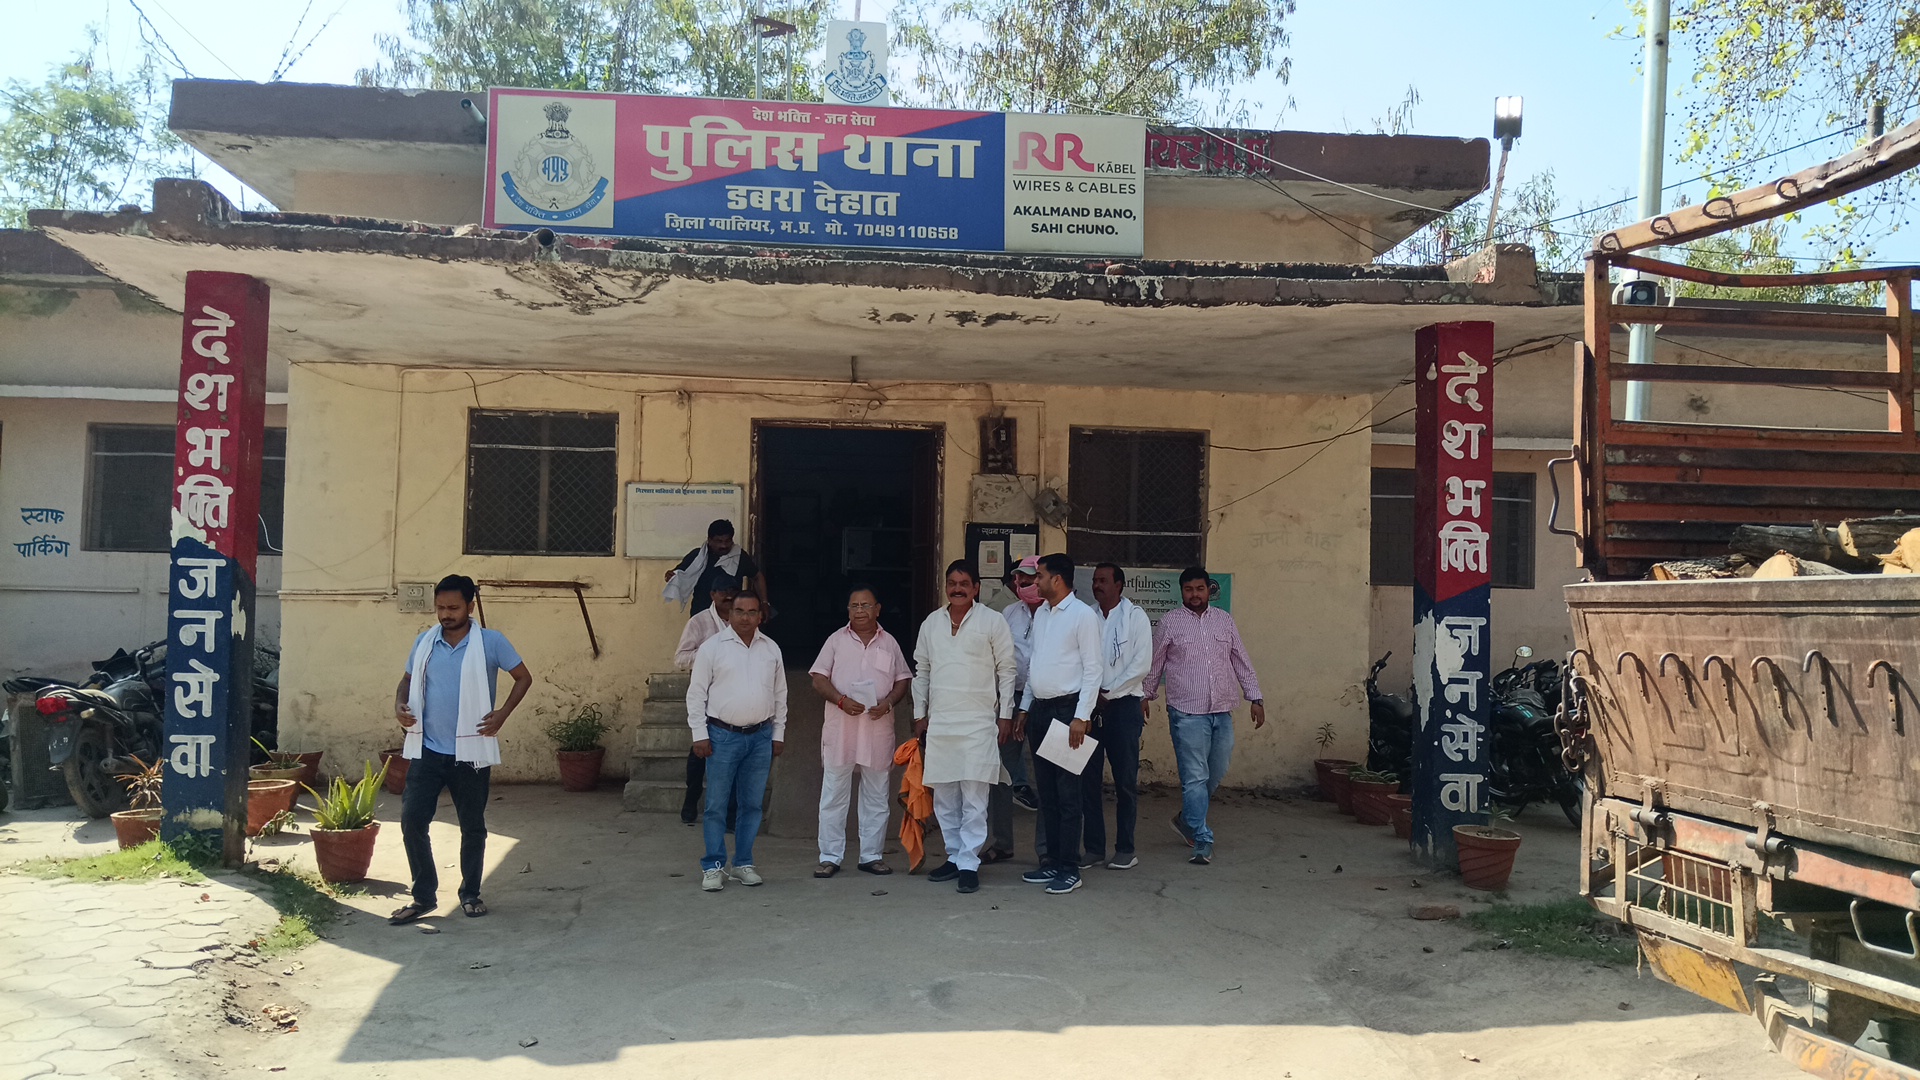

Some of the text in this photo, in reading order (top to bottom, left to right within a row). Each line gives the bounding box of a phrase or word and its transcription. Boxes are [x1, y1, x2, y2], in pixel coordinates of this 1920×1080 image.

[752, 106, 774, 122] देश
[777, 108, 811, 124] भक्ति
[824, 112, 847, 126] जन
[850, 111, 876, 127] सेवा
[642, 115, 982, 182] पुलिस थाना
[1013, 132, 1095, 172] RR
[1013, 180, 1136, 194] WIRES & CABLES
[725, 180, 900, 217] डबरा देहात
[1013, 205, 1137, 221] AKALMAND BANO,
[665, 213, 959, 240] ज़िला ग्वालियर, म.प्र. मो. 7049110658
[1031, 222, 1119, 235] SAHI CHUNO.
[20, 507, 65, 526] स्टाफ
[13, 533, 71, 558] पार्किंग
[1123, 575, 1171, 593] artfulness
